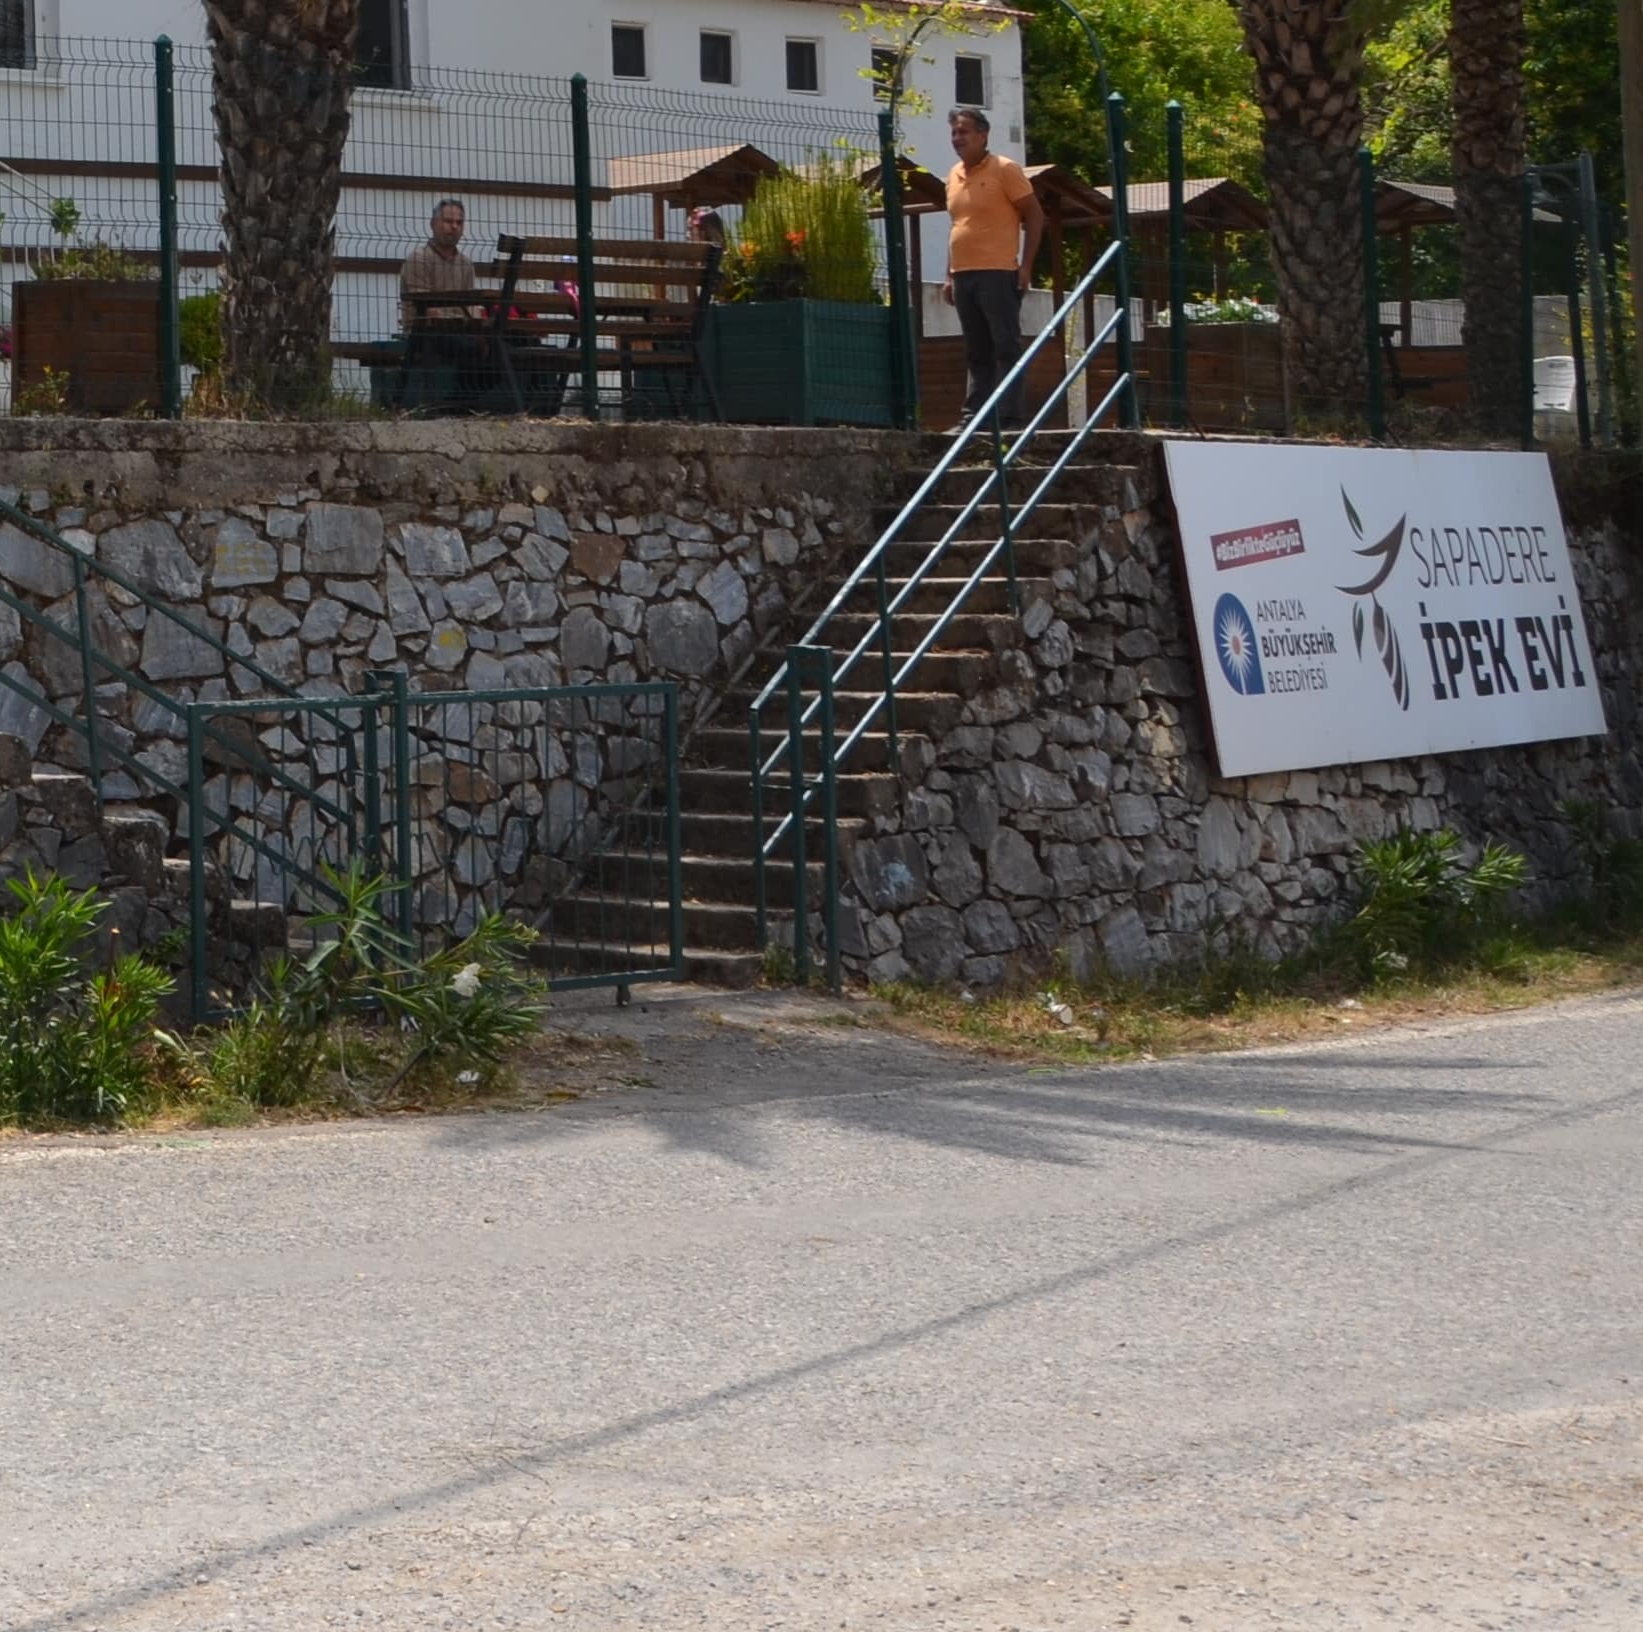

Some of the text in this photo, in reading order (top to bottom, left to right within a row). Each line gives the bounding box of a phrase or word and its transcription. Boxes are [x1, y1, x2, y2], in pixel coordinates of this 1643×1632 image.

[1409, 526, 1556, 589] SAPADERE
[1256, 599, 1307, 623] ANTALYA
[1261, 624, 1338, 661] BÜYÜKŞEHİR
[1418, 594, 1587, 701] İPEK EVİ
[1268, 661, 1329, 693] BELEDİYESİ
